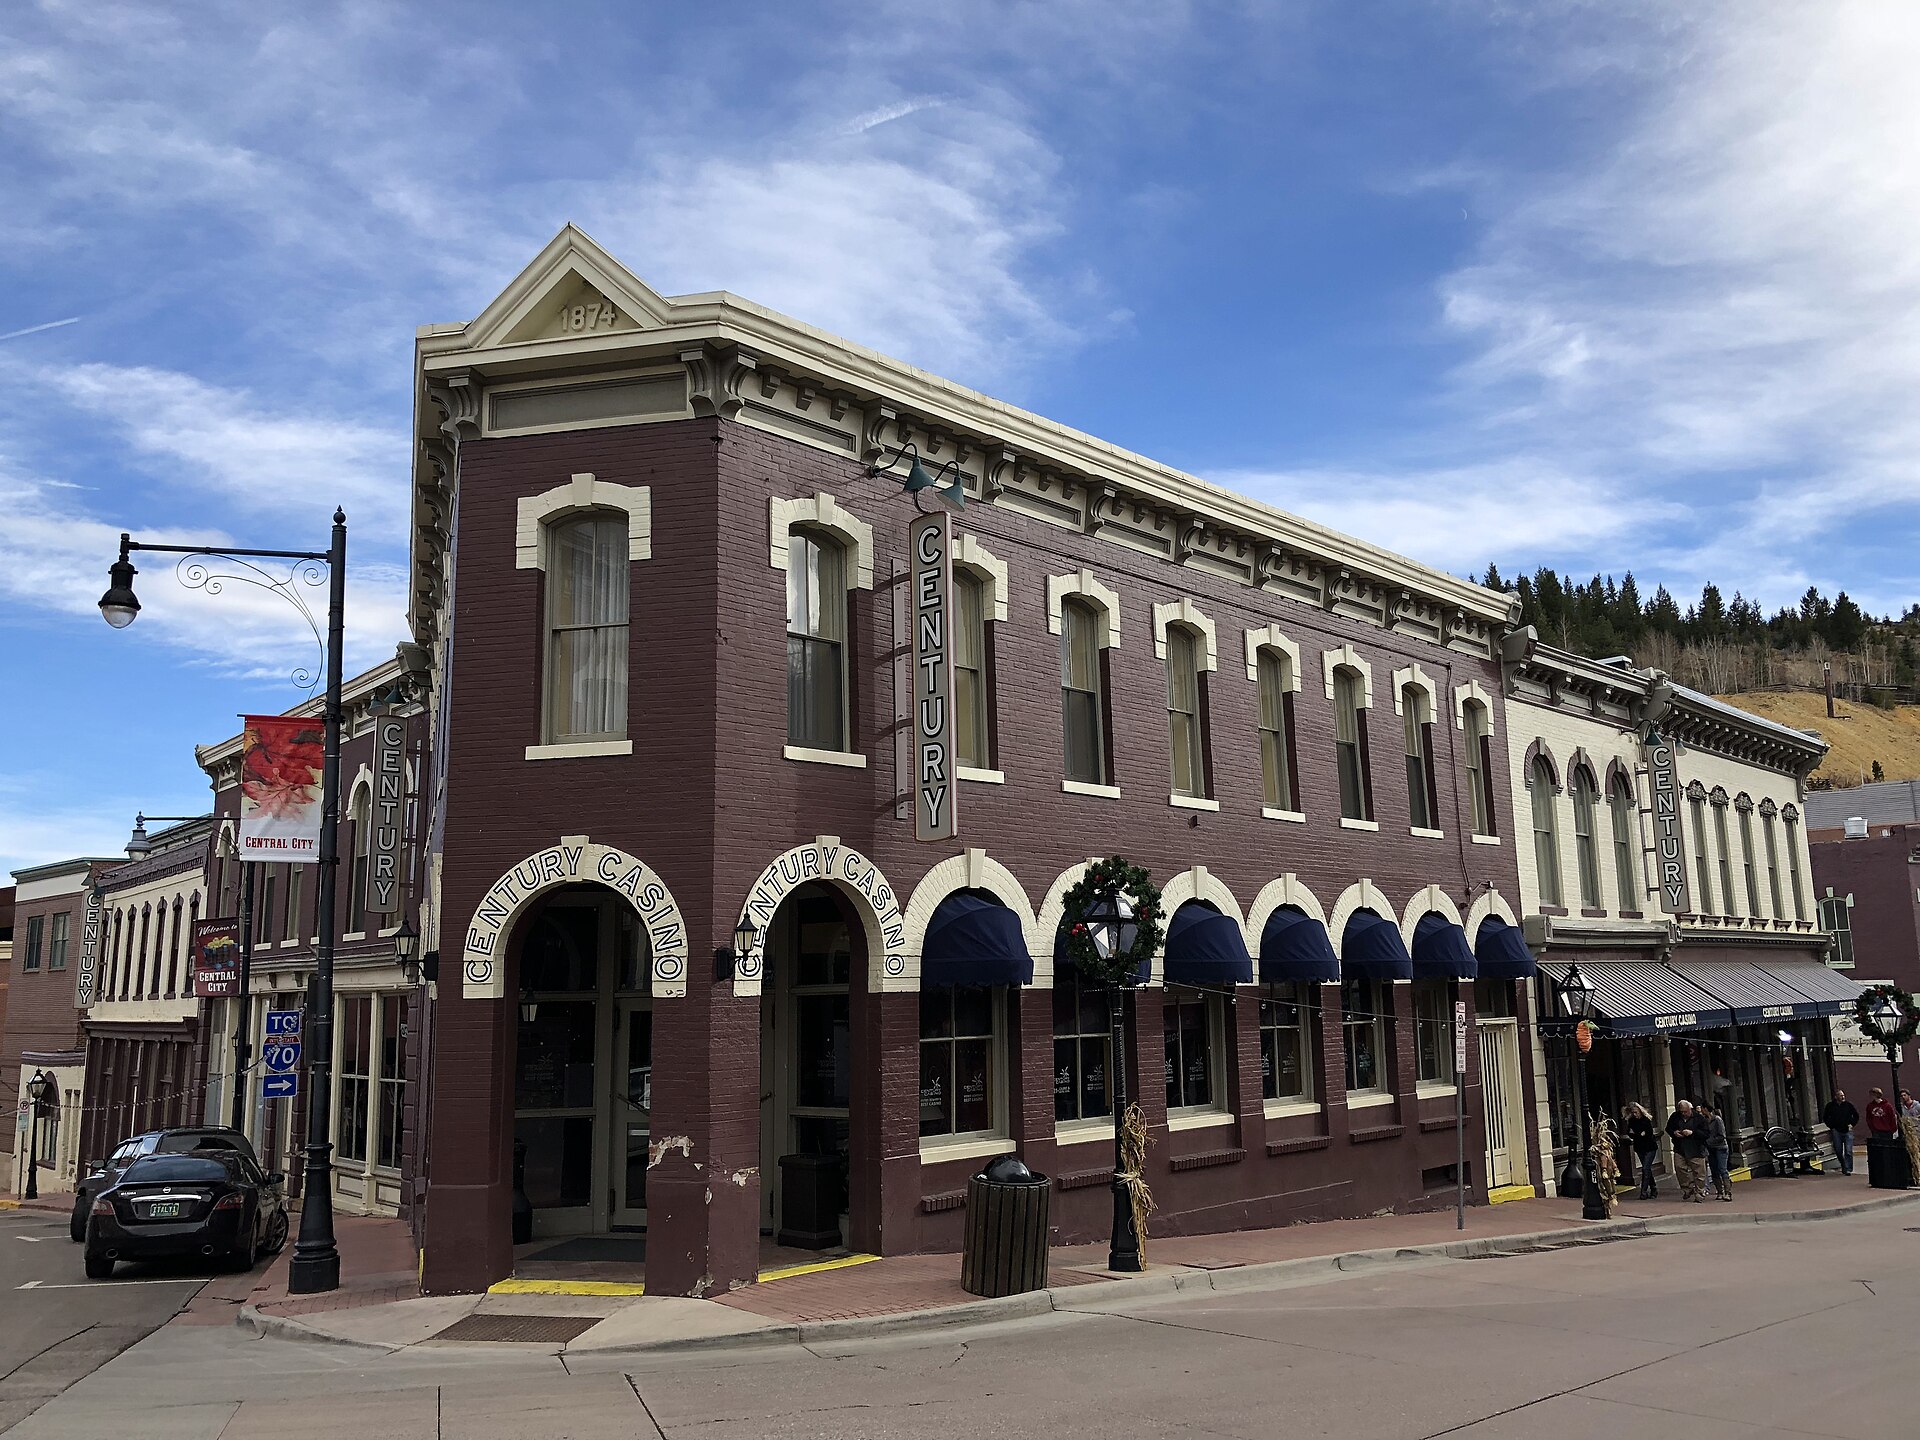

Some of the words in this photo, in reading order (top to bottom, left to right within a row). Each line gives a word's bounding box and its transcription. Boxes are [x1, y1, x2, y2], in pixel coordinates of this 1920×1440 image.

[561, 303, 616, 331] 1874
[917, 525, 948, 829] CENTURY
[374, 723, 403, 905] CENTURY
[1652, 746, 1684, 906] CENTURY
[245, 836, 288, 849] CENTRAL
[292, 837, 314, 850] CITY
[465, 846, 583, 983] CENTURY
[597, 852, 684, 980] CASINO
[843, 854, 906, 976] CASINO
[198, 925, 230, 937] Welcome
[77, 893, 101, 1005] CENTURY
[199, 971, 237, 982] CENTRAL
[207, 982, 228, 992] CITY
[1654, 1014, 1678, 1029] CENTURY
[1679, 1013, 1697, 1026] CASINO
[268, 1047, 295, 1065] 70
